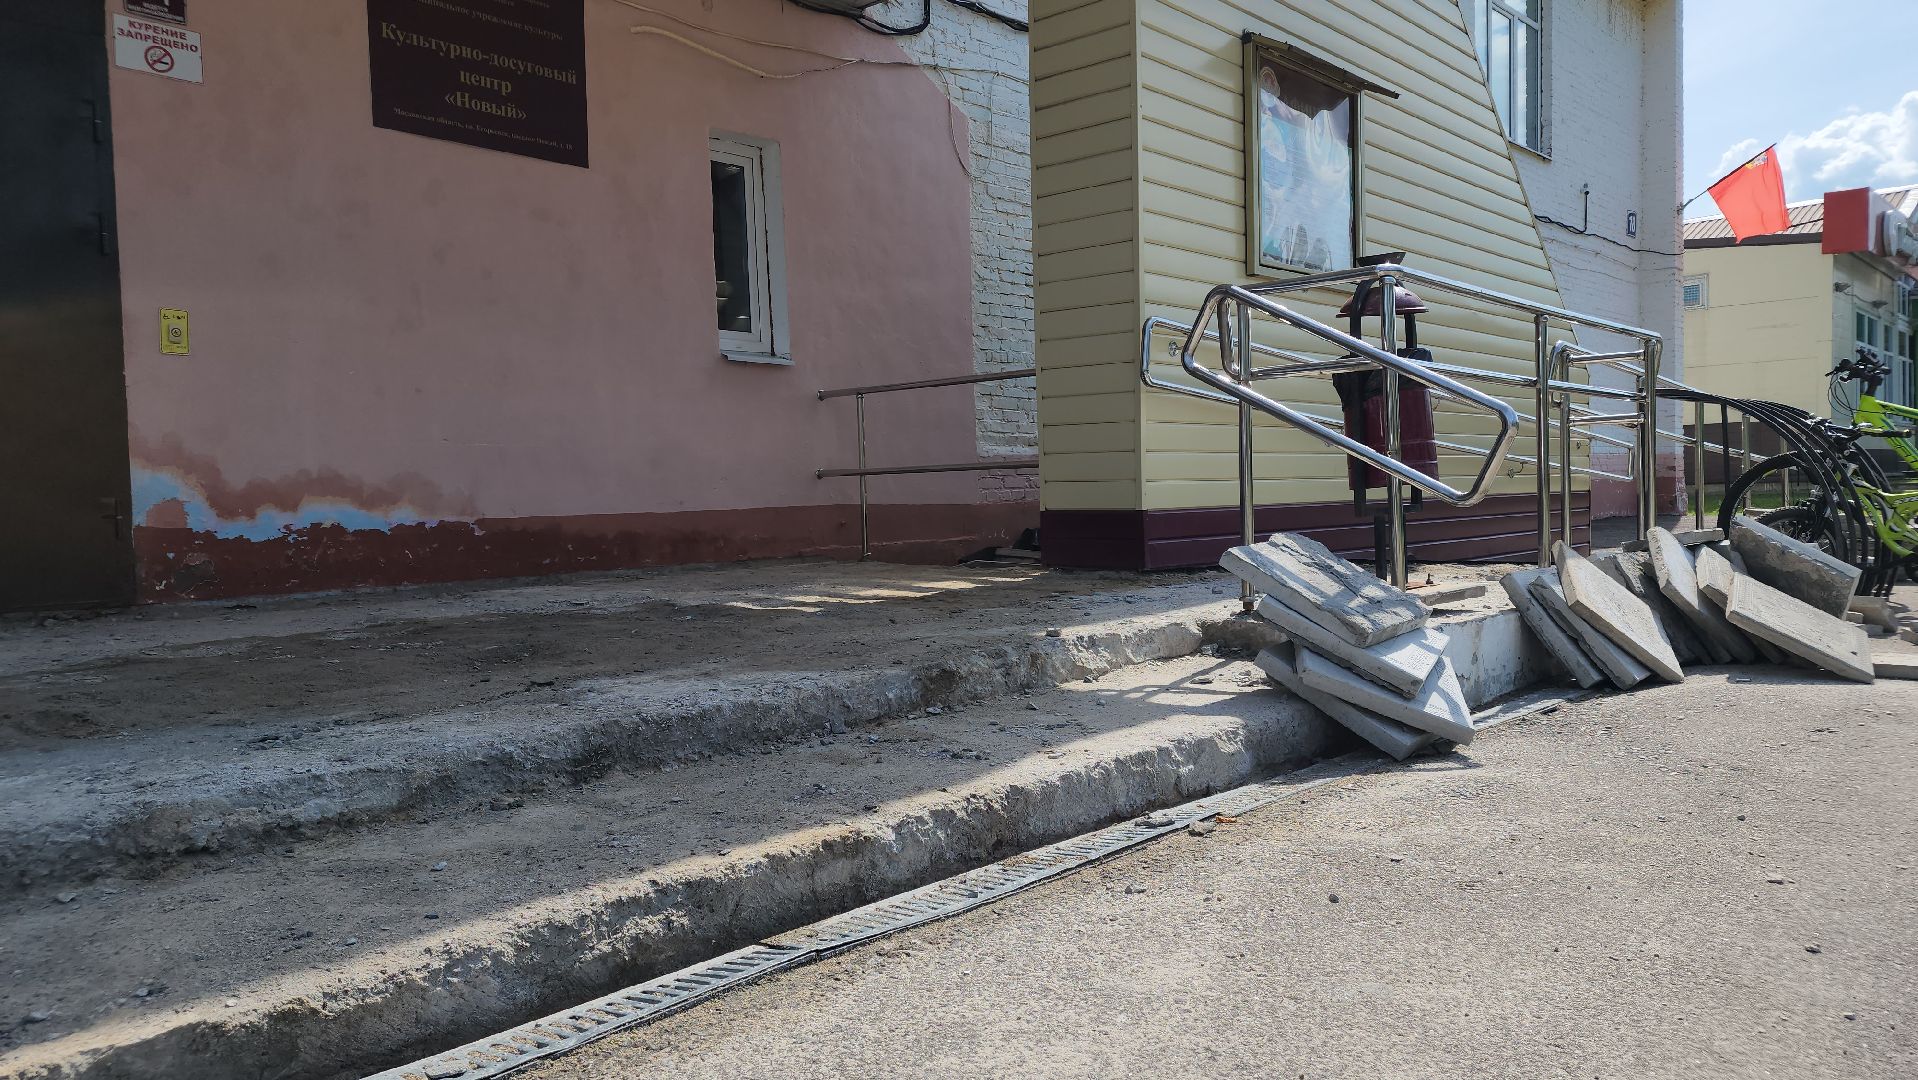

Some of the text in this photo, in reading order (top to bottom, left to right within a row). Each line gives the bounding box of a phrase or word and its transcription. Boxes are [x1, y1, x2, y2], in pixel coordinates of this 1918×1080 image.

[117, 27, 198, 53] ЗАПРЕЩЕНО
[128, 20, 187, 40] КУРЕНИЕ
[382, 22, 576, 84] Культурно-досуговый
[459, 71, 512, 97] центр
[445, 92, 527, 120] «Новый»
